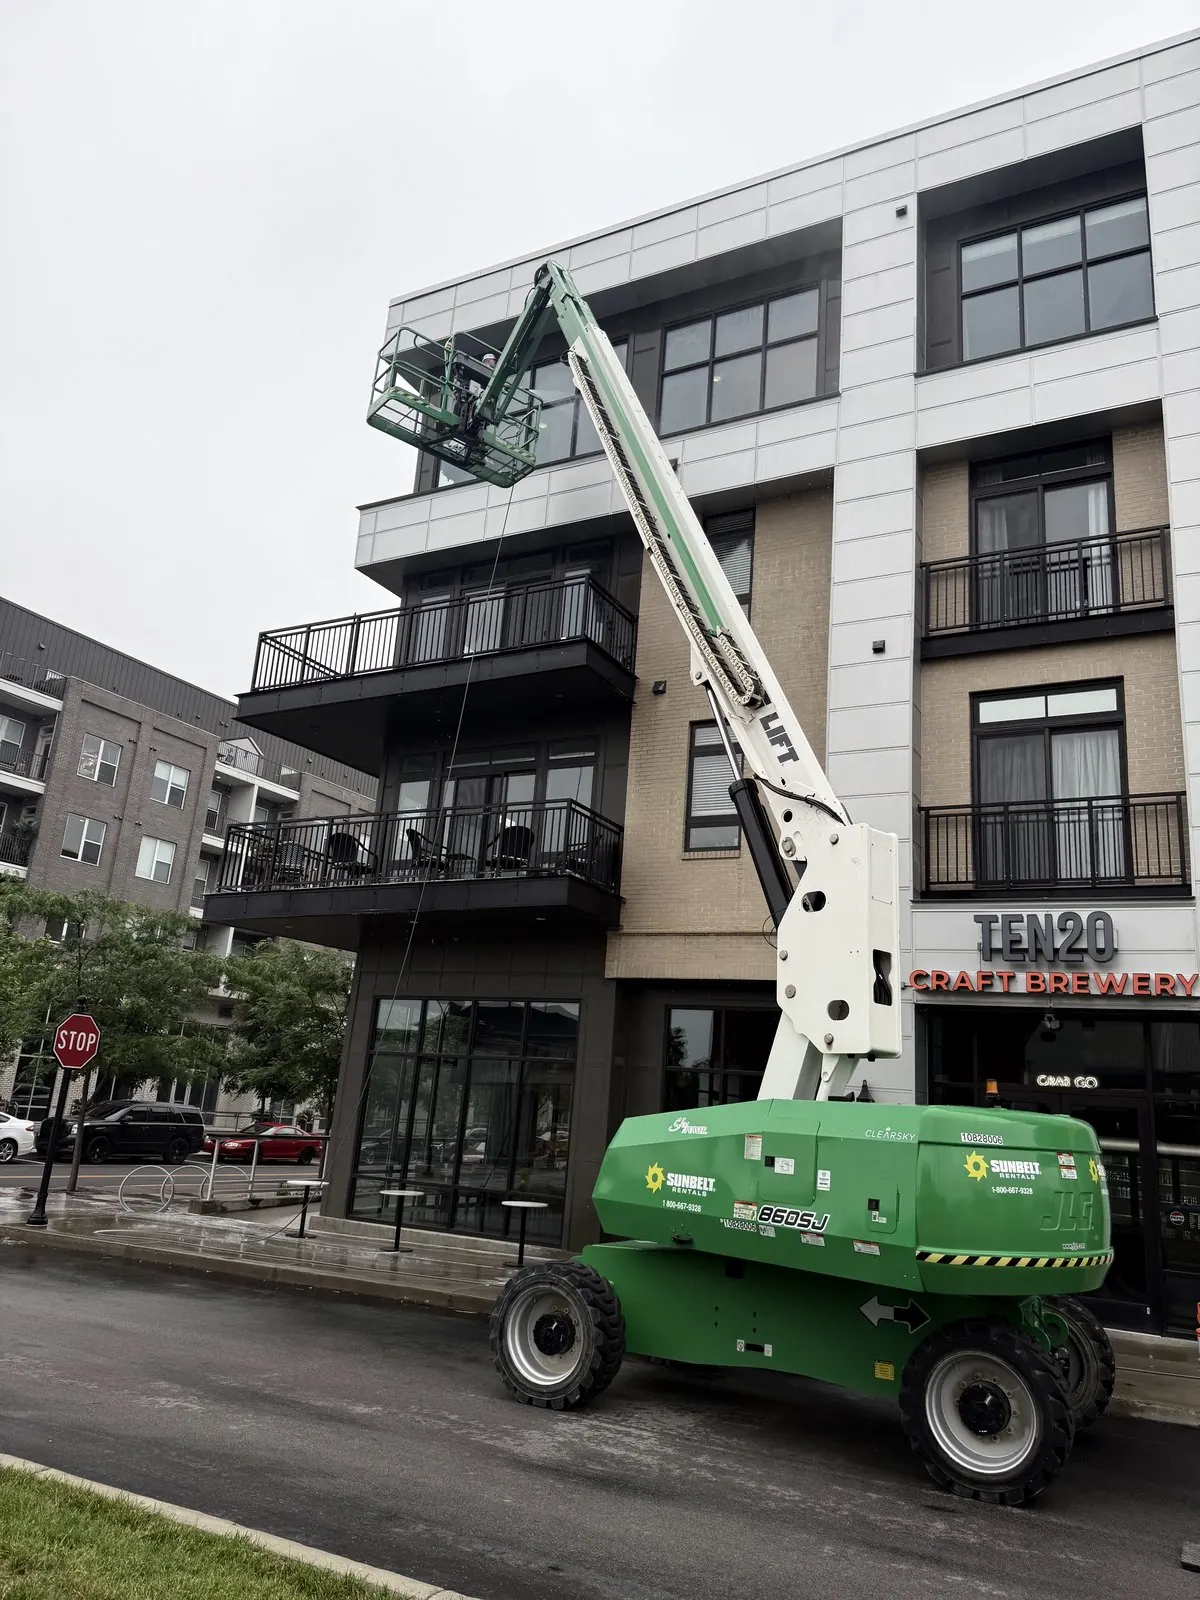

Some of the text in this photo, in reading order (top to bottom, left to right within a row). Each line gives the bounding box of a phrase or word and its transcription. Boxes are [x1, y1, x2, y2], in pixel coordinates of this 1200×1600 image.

[759, 711, 800, 764] LIFT
[973, 910, 1115, 963] TEN20
[908, 969, 1200, 997] CRAFT BREWERY
[57, 1030, 97, 1052] STOP
[1074, 1076, 1098, 1089] GO
[864, 1128, 917, 1141] CLEARSKY
[961, 1133, 1003, 1145] 10828006
[990, 1159, 1041, 1175] SUNBELT
[999, 1172, 1036, 1180] RENTALS
[666, 1172, 716, 1192] SUNBELT
[671, 1186, 707, 1197] RENTALS
[758, 1204, 831, 1232] 860SJ
